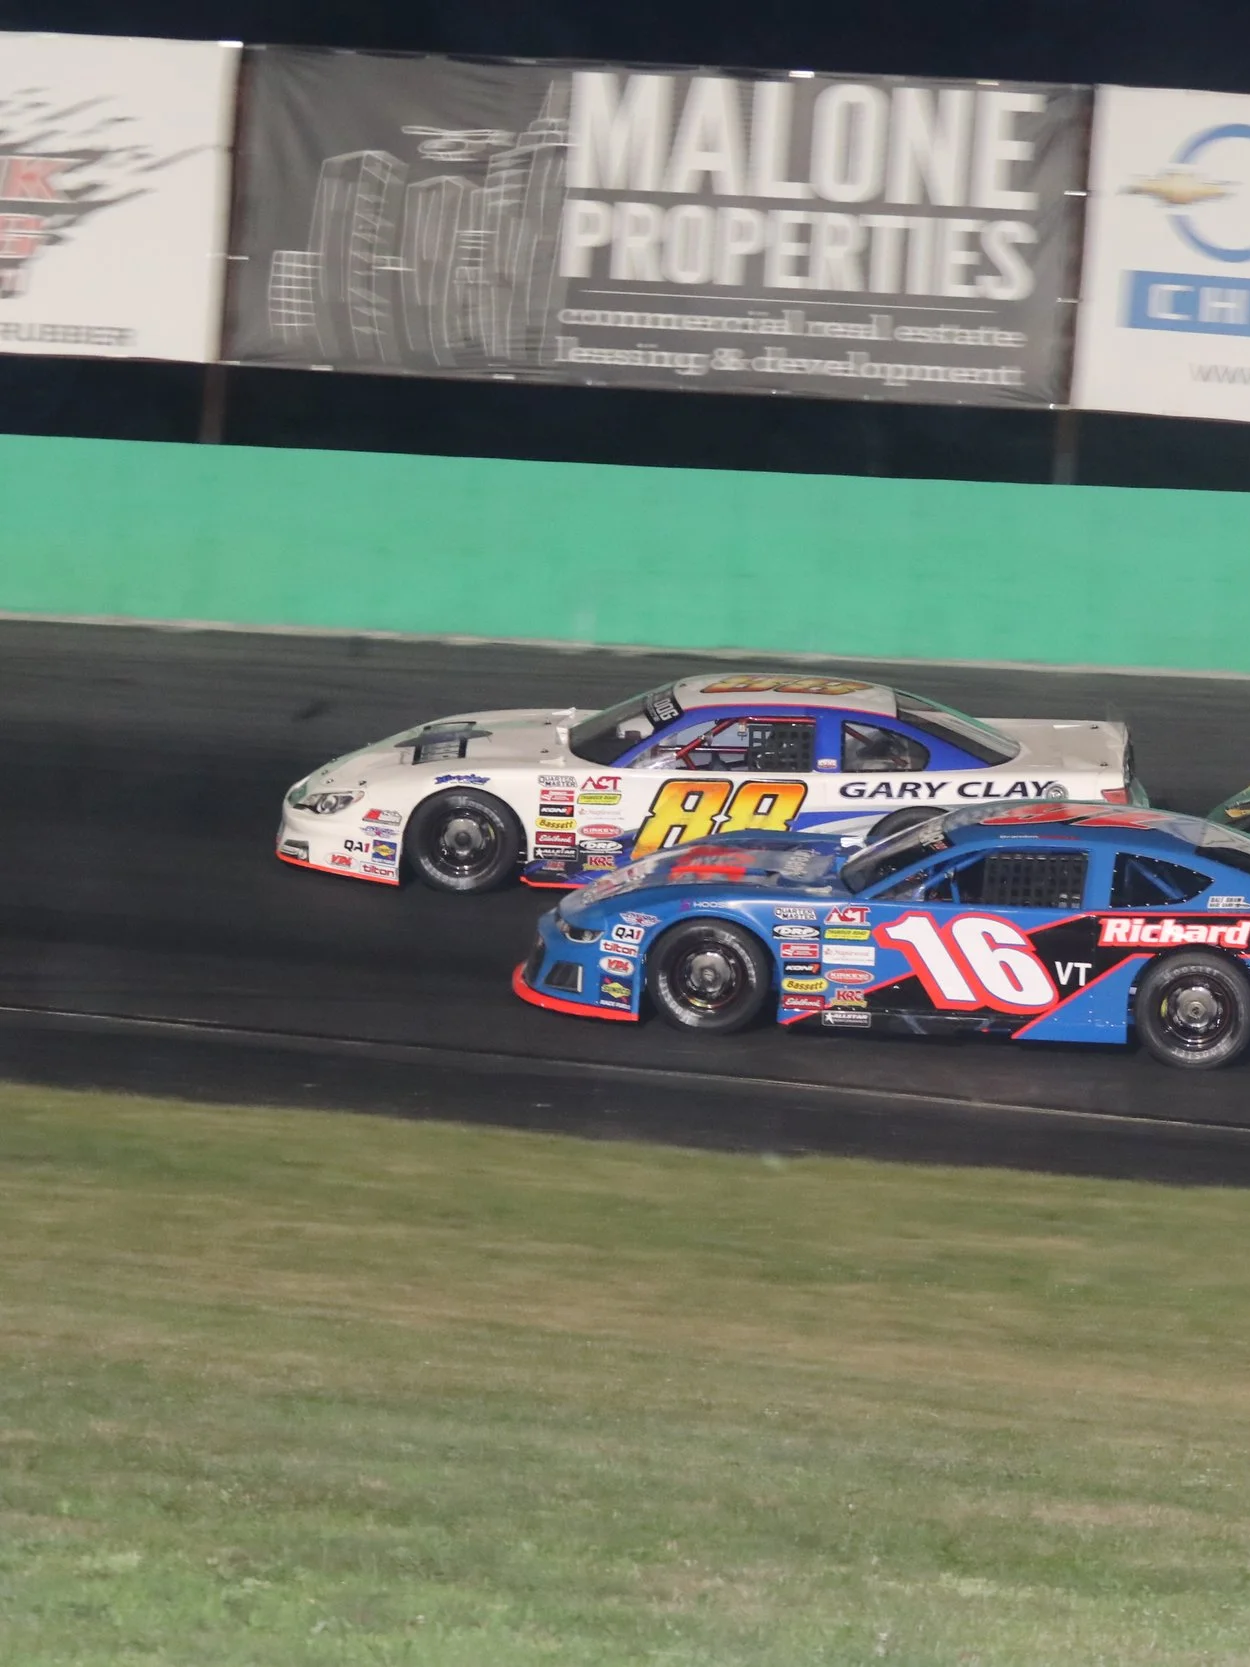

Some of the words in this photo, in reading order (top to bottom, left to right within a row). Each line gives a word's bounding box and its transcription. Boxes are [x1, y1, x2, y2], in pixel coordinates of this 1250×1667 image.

[566, 72, 1048, 210] MALONE
[559, 199, 1038, 301] PROPERTIES
[557, 306, 804, 335] commercial
[806, 311, 893, 341] real
[893, 321, 1027, 348] estate
[555, 335, 710, 376] leasing
[711, 347, 749, 371] &
[751, 346, 1025, 387] development
[581, 776, 622, 790] ACT
[839, 781, 946, 799] GARY
[957, 781, 1054, 799] CLAY
[539, 819, 573, 829] Bassett
[632, 778, 810, 860] 88
[344, 839, 370, 854] QA1
[590, 856, 614, 866] KRC
[362, 864, 395, 878] tilton
[826, 906, 870, 922] ACT
[615, 926, 642, 941] QA1
[603, 941, 637, 956] tilton
[880, 912, 1057, 1011] 16
[1055, 961, 1092, 986] VT
[786, 980, 823, 990] Bassett
[837, 990, 864, 1001] KRC
